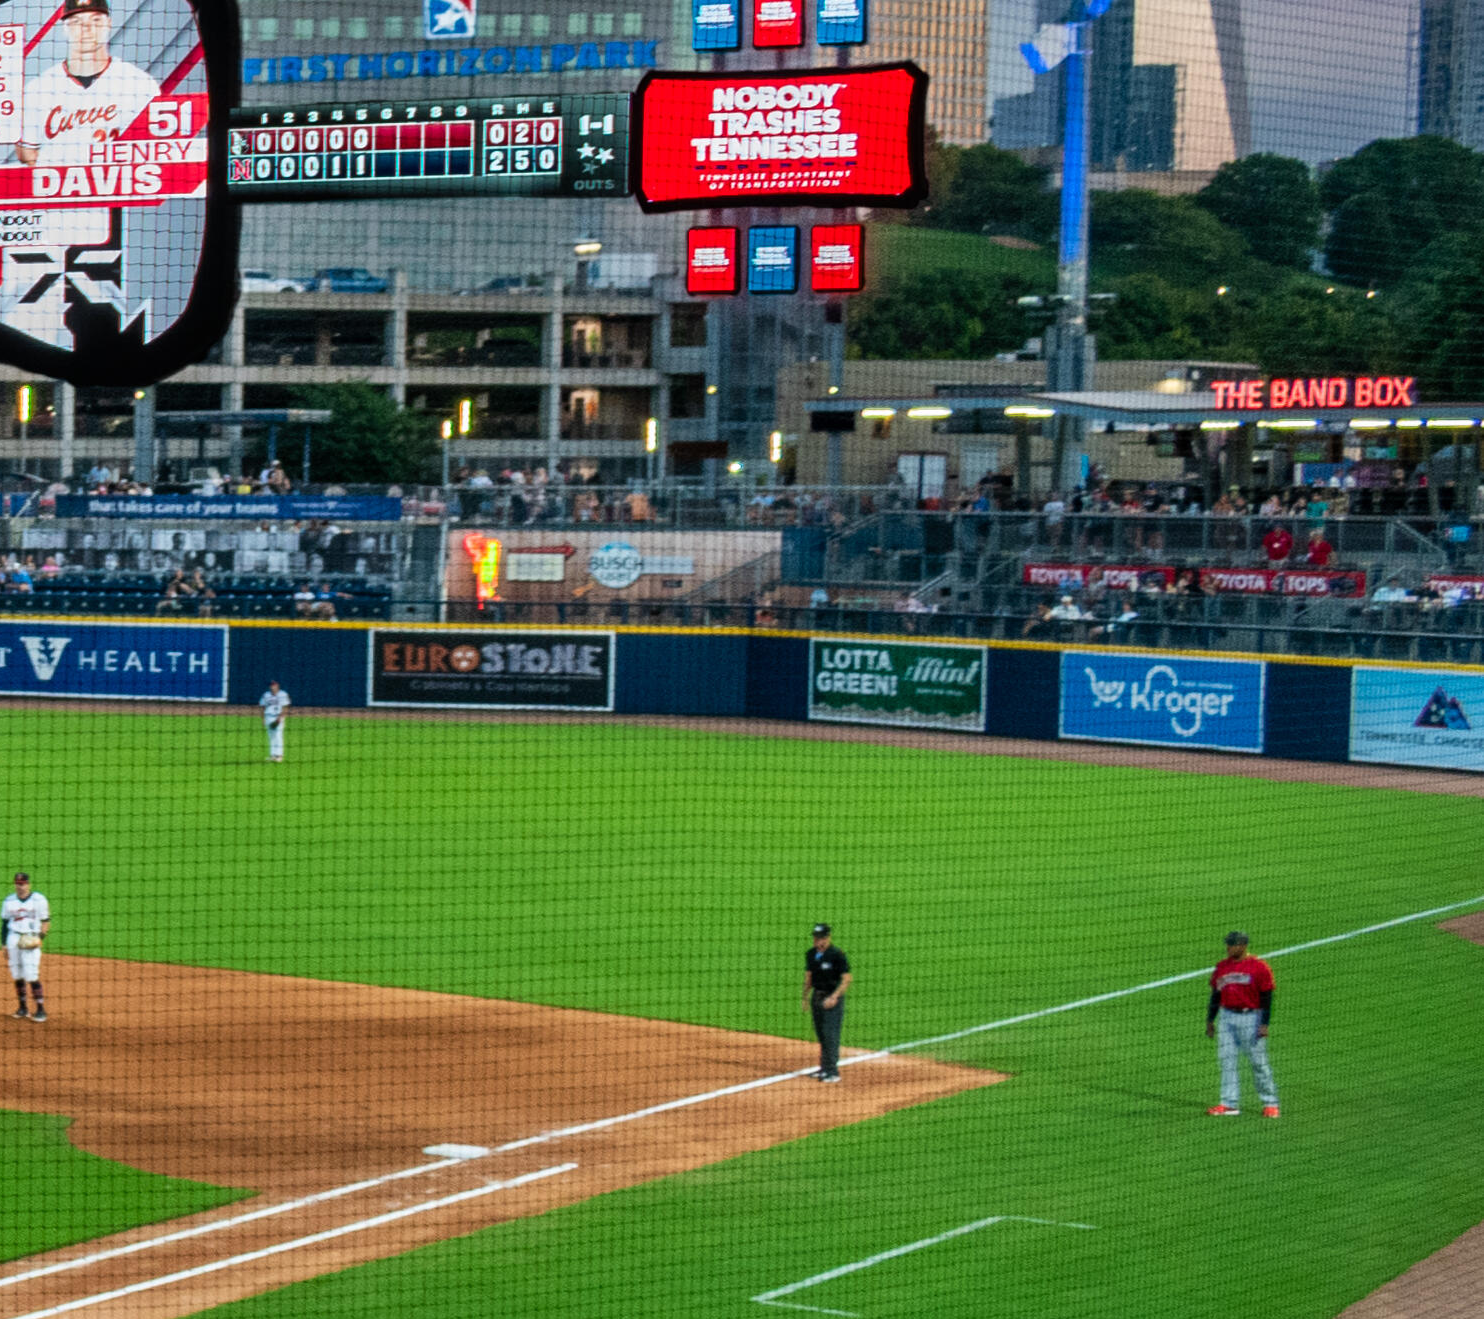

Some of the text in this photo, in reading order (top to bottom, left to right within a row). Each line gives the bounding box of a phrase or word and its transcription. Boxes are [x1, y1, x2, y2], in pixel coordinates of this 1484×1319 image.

[243, 39, 657, 86] FIRST HORIZON PARK
[712, 84, 842, 111] NOBODY
[45, 104, 117, 139] Curve
[148, 101, 192, 137] 51
[708, 109, 841, 136] TRASHES
[257, 122, 555, 152] 0 0 0 0 0 0 2 0
[690, 133, 858, 161] TENNESSEE
[89, 141, 192, 163] HENRY
[257, 151, 504, 178] 0 0 0 2
[32, 164, 163, 197] DAVIS
[574, 180, 615, 190] OUTS
[699, 170, 852, 181] TENNESSEE DEPARTMENT
[731, 180, 840, 189] TRANSPORTATION
[1211, 377, 1413, 409] THE BAND BOX
[89, 501, 115, 513] that
[118, 501, 153, 514] takes
[155, 503, 184, 514] care
[186, 501, 201, 514] of
[202, 503, 233, 517] your
[235, 502, 279, 515] teams
[591, 556, 644, 571] BUSCH
[78, 649, 210, 674] HEALTH
[822, 648, 892, 671] LOTTA
[905, 656, 981, 686] Mint
[816, 671, 898, 696] GREEN!
